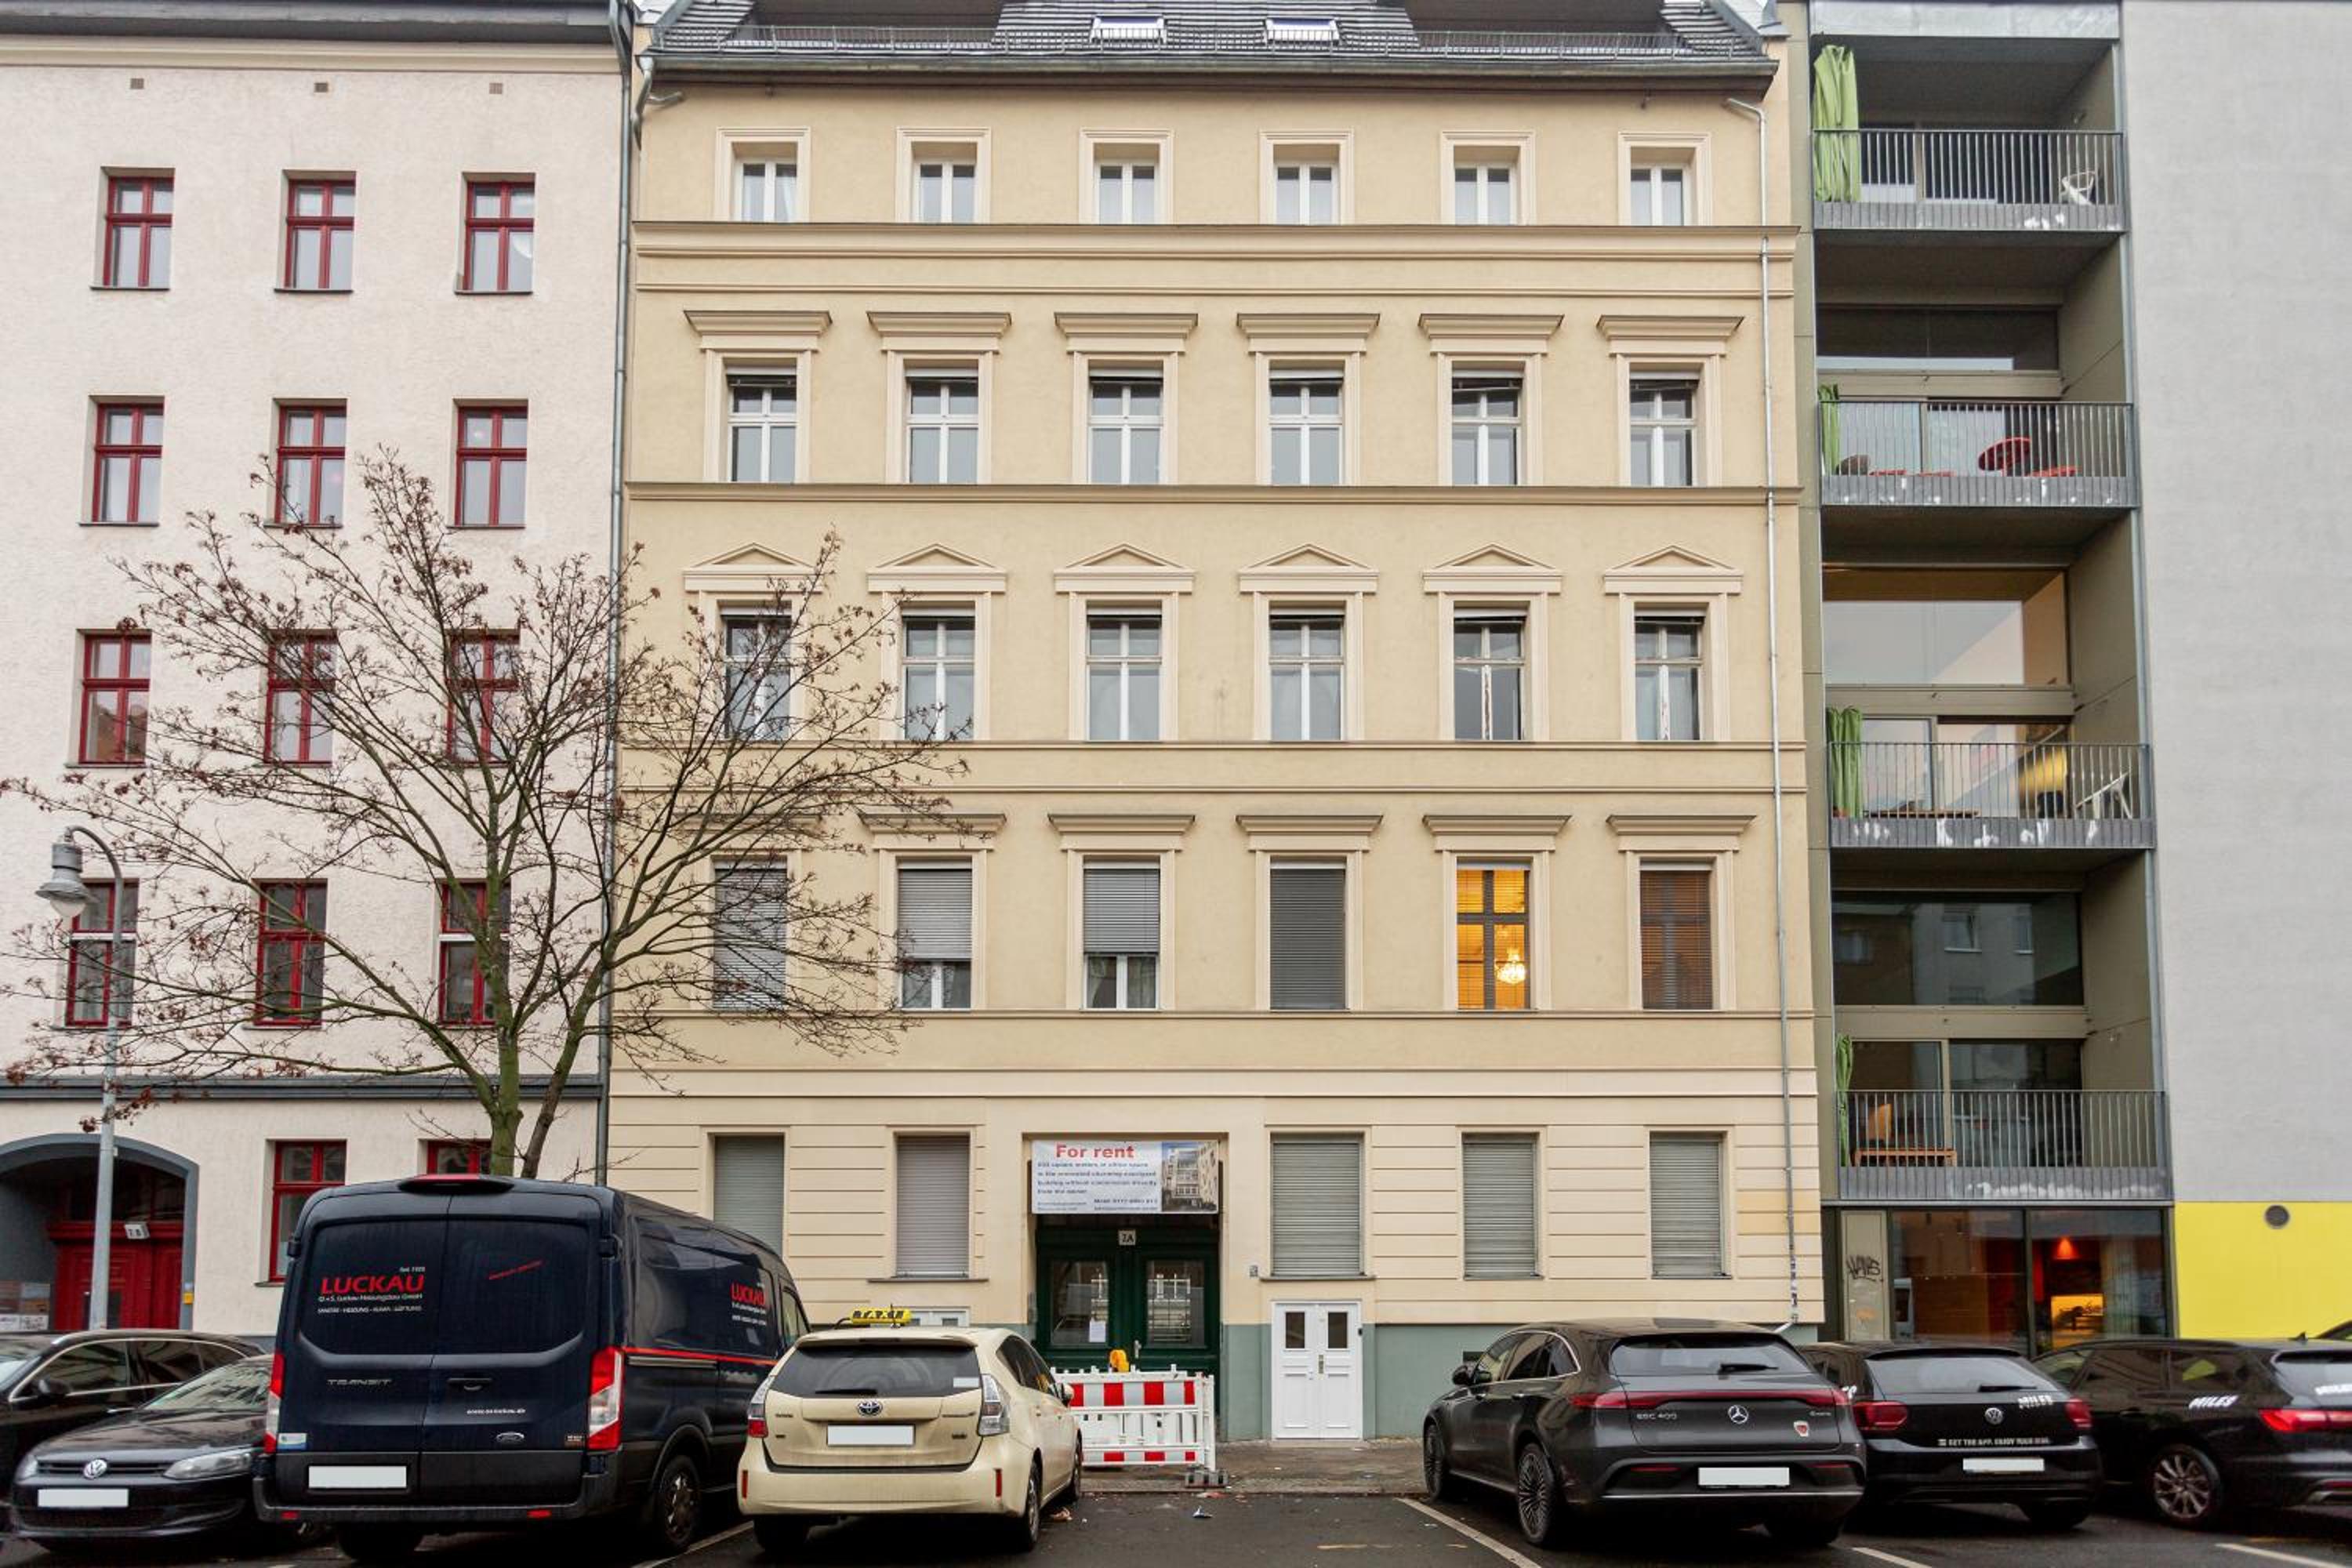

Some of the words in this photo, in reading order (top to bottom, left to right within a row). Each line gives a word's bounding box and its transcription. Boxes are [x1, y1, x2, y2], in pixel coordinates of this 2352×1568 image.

[1055, 1144, 1087, 1158] For
[1093, 1145, 1134, 1158] rent
[321, 1274, 425, 1294] LUCKAU
[2188, 1395, 2239, 1410] MILES
